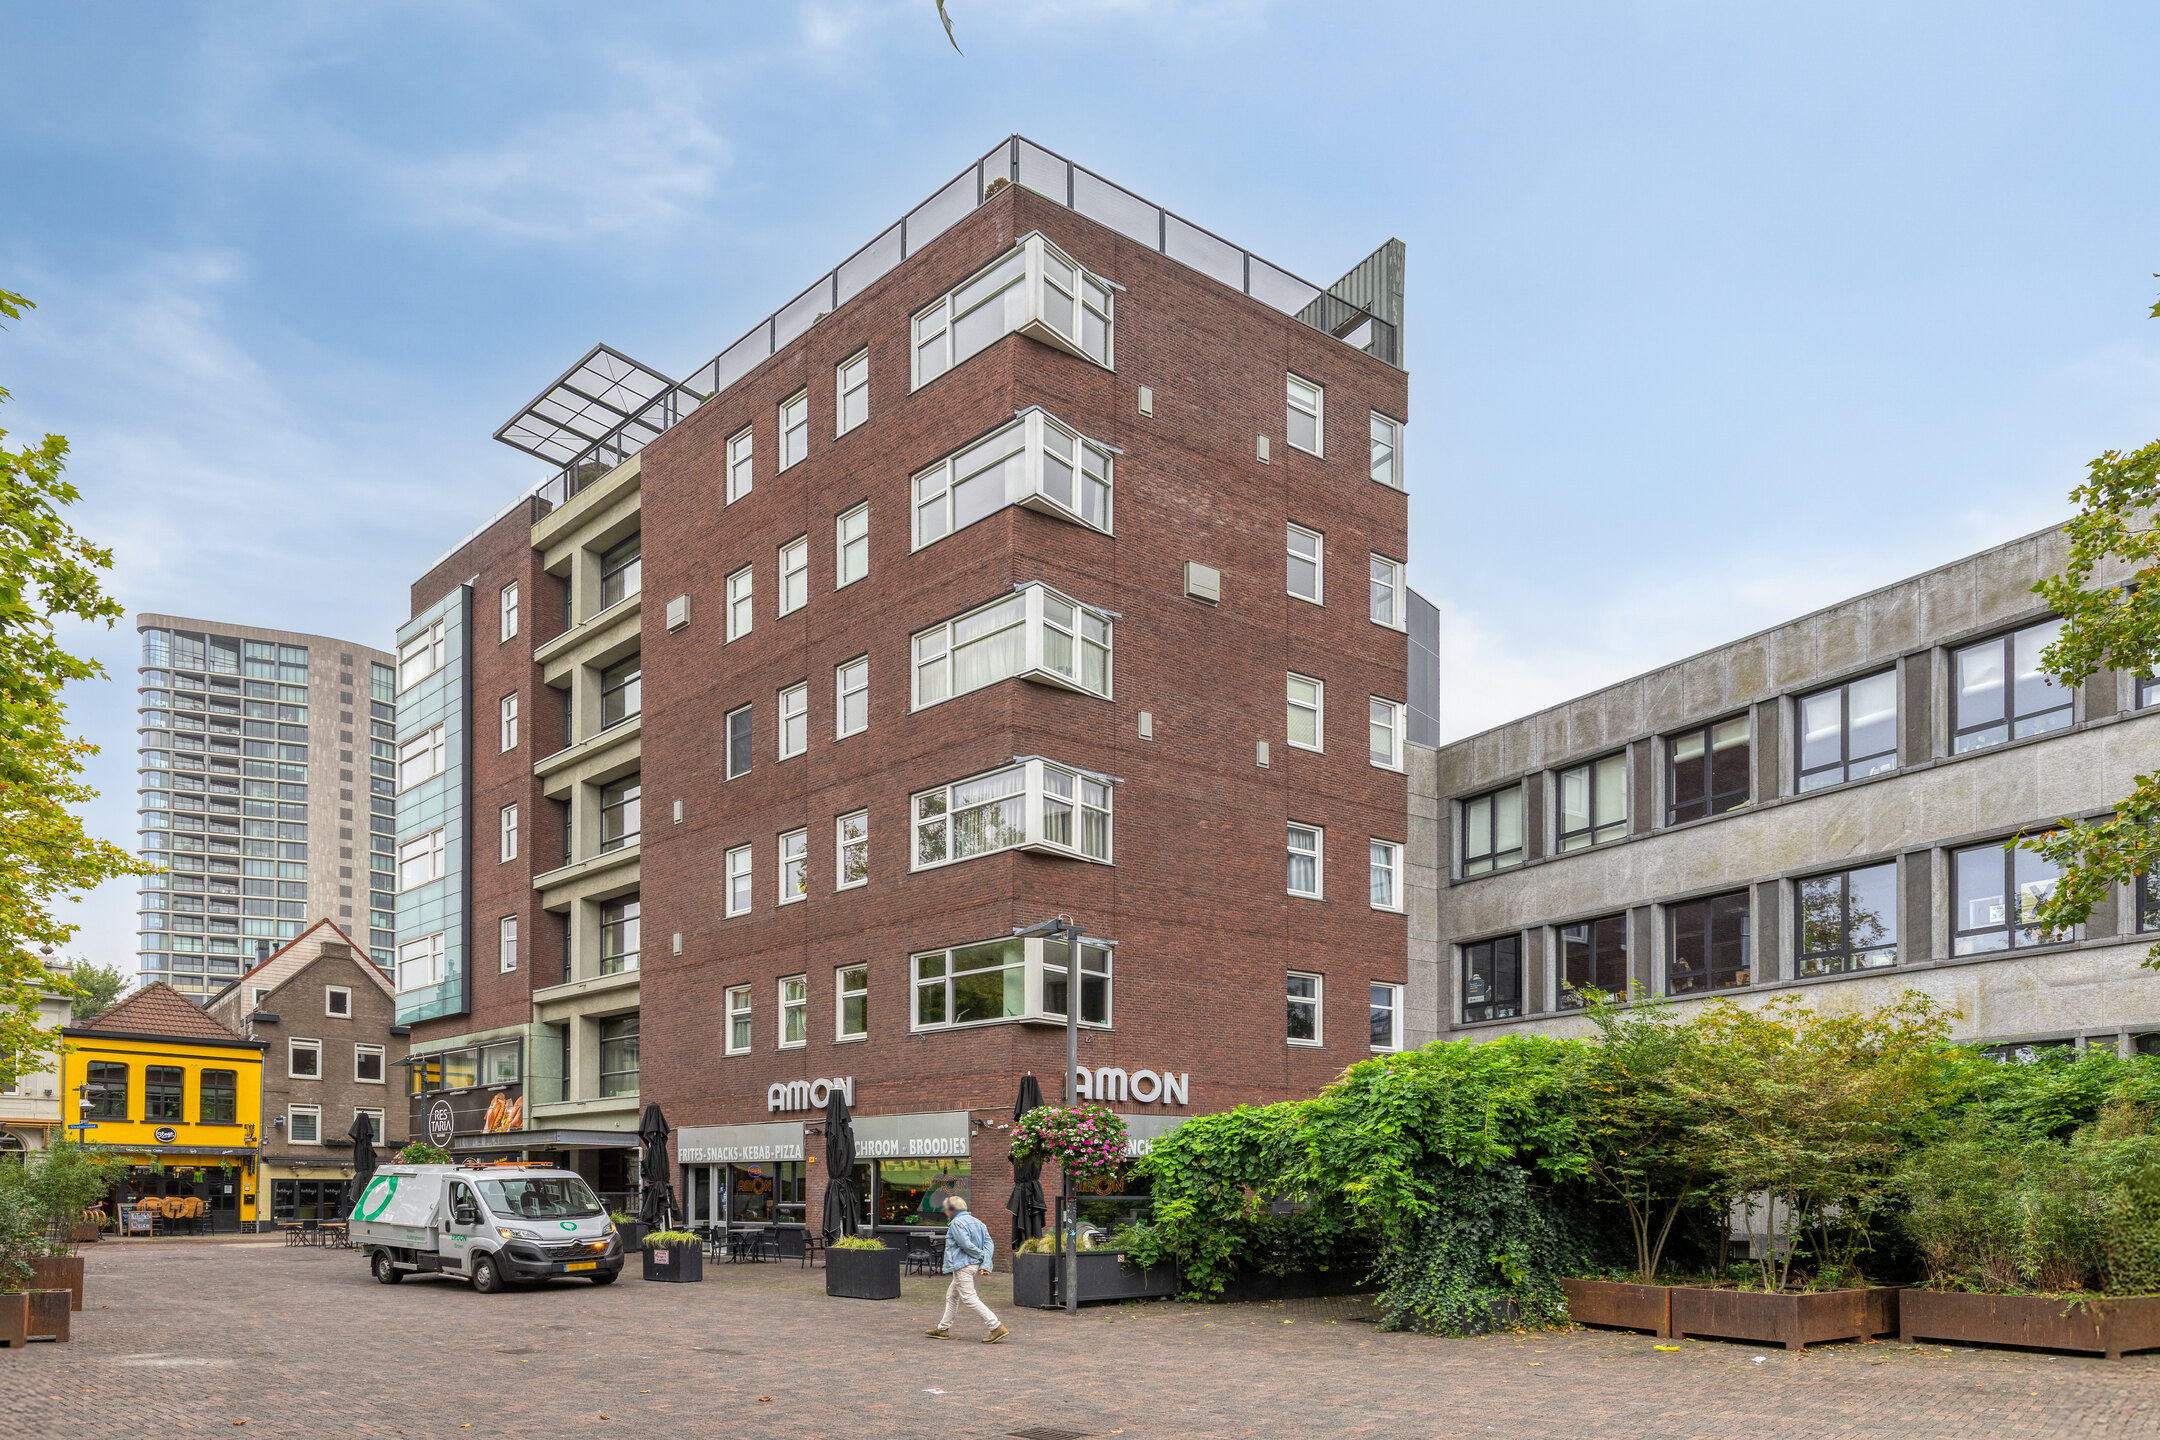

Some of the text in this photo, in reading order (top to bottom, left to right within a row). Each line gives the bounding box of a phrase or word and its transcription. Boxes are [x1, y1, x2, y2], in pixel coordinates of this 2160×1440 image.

[768, 1076, 855, 1112] AMON
[1065, 1066, 1189, 1105] AMON
[434, 1109, 448, 1121] RES
[431, 1121, 452, 1132] TARIA
[855, 1137, 966, 1156] CHROOM BROODJES
